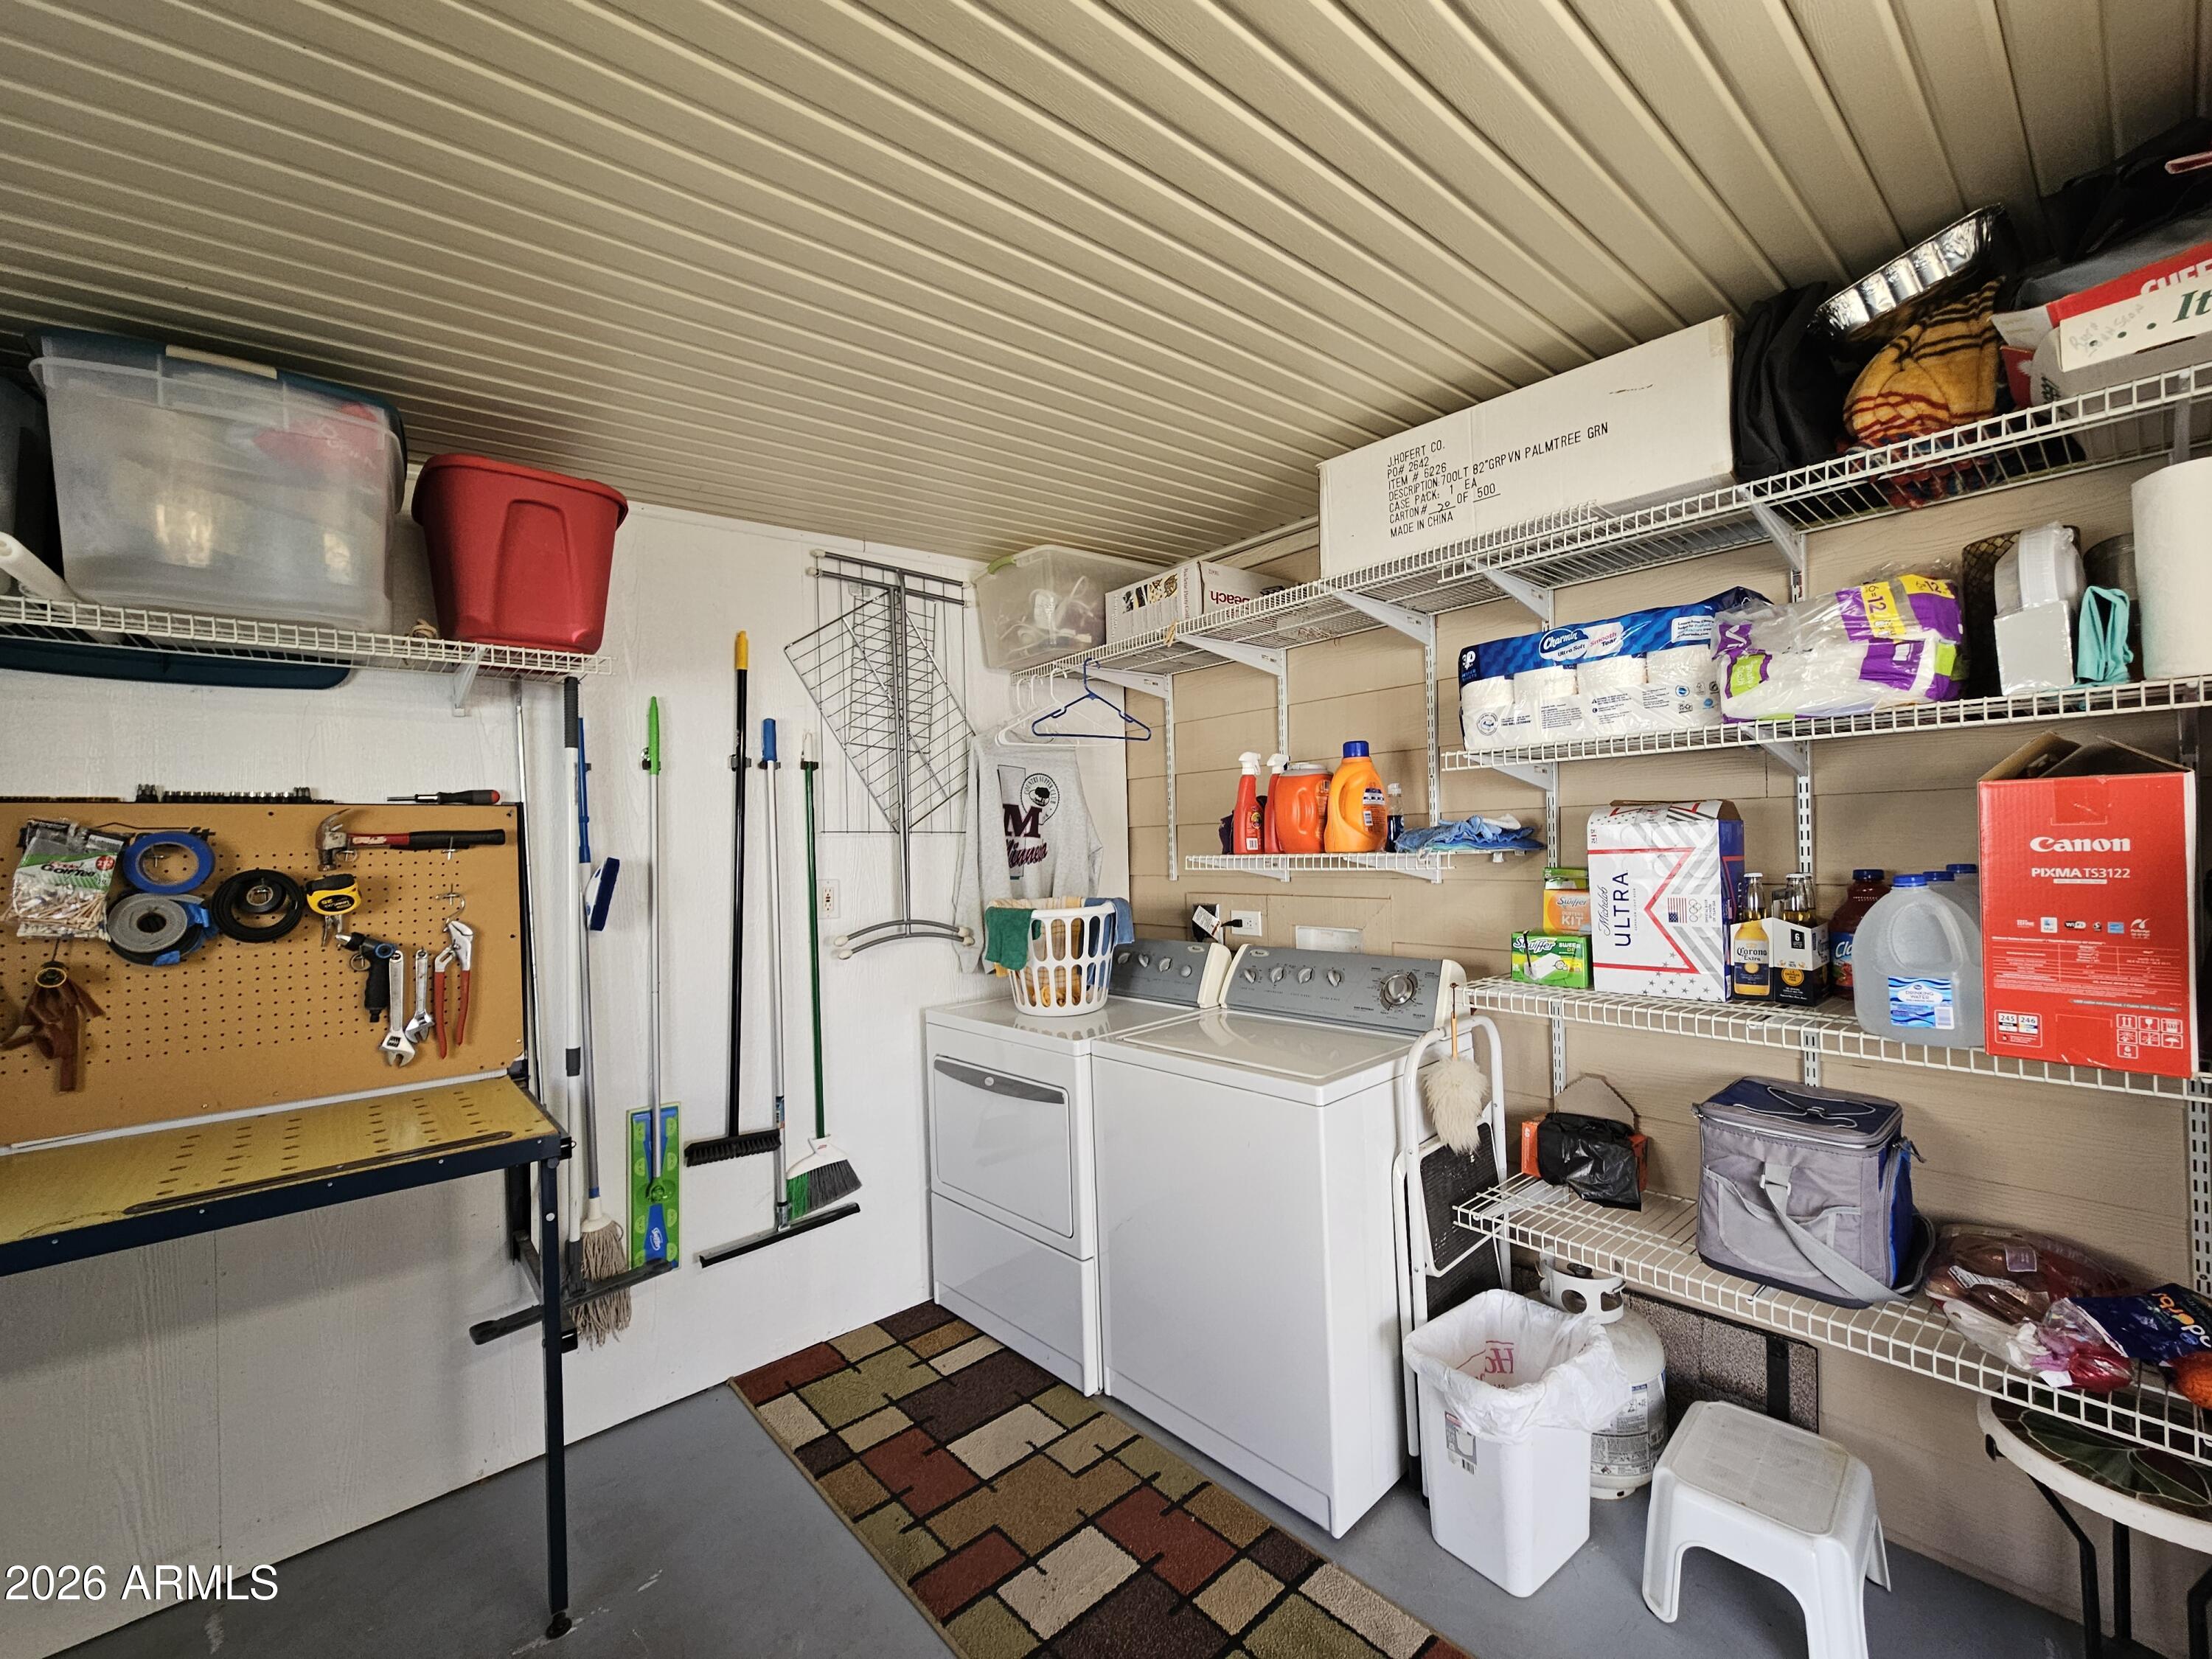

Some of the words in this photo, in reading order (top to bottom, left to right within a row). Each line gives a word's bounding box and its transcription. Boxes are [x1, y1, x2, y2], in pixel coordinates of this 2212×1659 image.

[1525, 431, 1582, 459] PALMTREE
[1587, 422, 1608, 439] GRN
[1387, 445, 1426, 467] J.HOFERT
[1430, 439, 1445, 453] CO.
[1408, 456, 1429, 472] 2642
[1388, 477, 1408, 490] ITEM
[1424, 462, 1447, 479] 6226
[1389, 498, 1411, 513] CASE
[1415, 490, 1440, 505] PACK:
[1450, 484, 1453, 495] 1
[1464, 477, 1478, 490] EA
[1457, 493, 1469, 504] OF
[1477, 483, 1496, 498] 500
[1391, 522, 1413, 538] MADE
[1417, 519, 1425, 531] IN
[1427, 511, 1453, 527] CHINA
[1543, 632, 1579, 650] Charmin
[1590, 632, 1617, 647] Smooth
[1601, 637, 1617, 647] Tear
[1557, 648, 1573, 657] Ultra
[1023, 776, 1039, 795] COUNTRY
[1003, 804, 1043, 838] M
[2029, 836, 2131, 852] Canon
[2031, 867, 2082, 877] PIXMA
[2082, 868, 2131, 878] TS3122
[1557, 896, 1587, 908] Swiffer
[1597, 885, 1611, 936] Michelob
[1612, 872, 1632, 947] ULTRA
[1561, 917, 1584, 926] KIT
[1795, 933, 1800, 942] 6
[1736, 947, 1767, 956] Corona
[2020, 1016, 2036, 1024] 246
